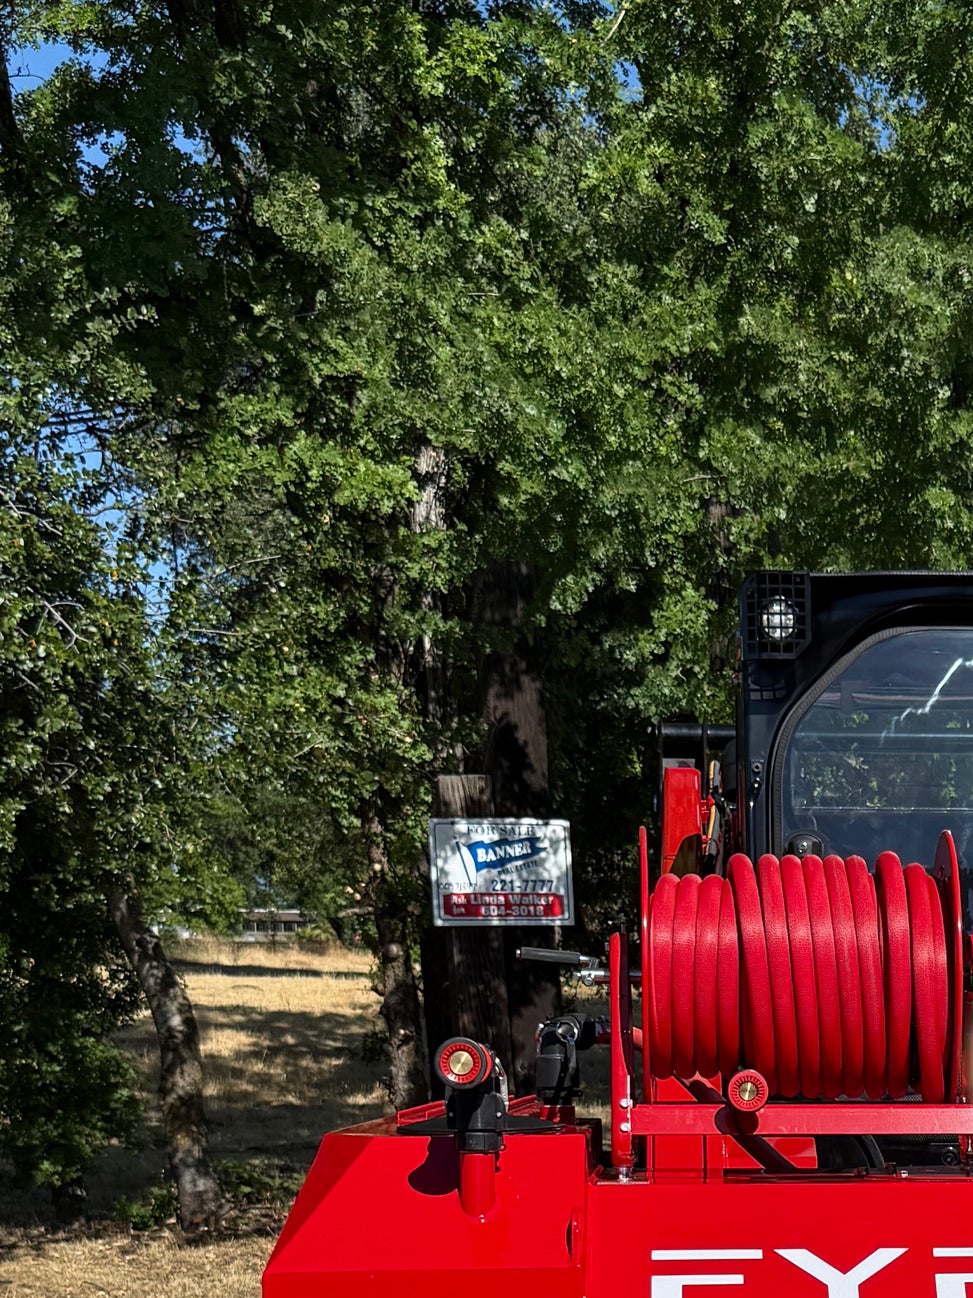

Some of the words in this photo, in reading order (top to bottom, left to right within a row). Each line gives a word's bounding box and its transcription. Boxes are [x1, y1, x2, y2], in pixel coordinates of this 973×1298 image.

[466, 825, 496, 836] FOR
[500, 825, 537, 836] SALE
[476, 841, 532, 862] BANNER
[491, 880, 554, 892] 221-7777
[471, 895, 505, 905] Linda
[509, 895, 554, 906] Walker
[481, 905, 544, 916] 604-3018
